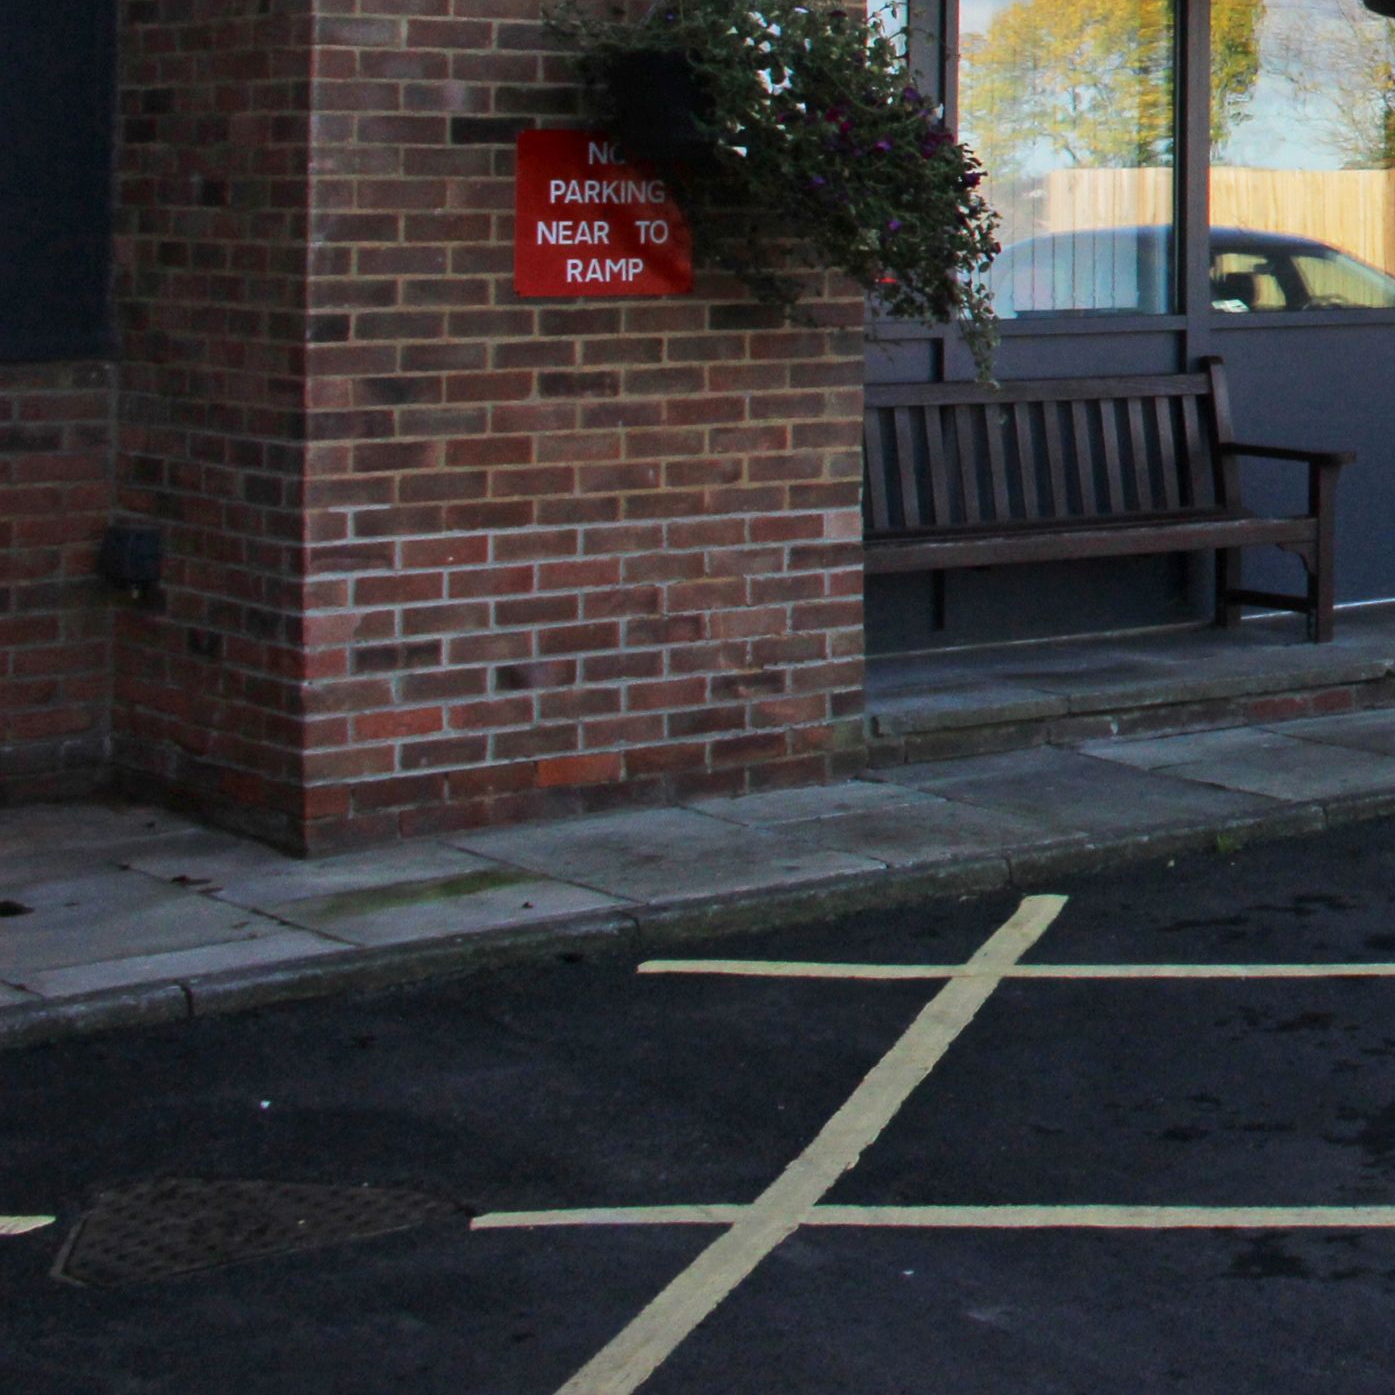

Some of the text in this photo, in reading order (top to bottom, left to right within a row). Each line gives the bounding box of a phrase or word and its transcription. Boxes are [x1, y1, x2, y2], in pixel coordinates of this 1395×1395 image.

[549, 179, 666, 204] PARKING
[536, 219, 669, 245] NEAR TO
[566, 258, 643, 283] RAMP
